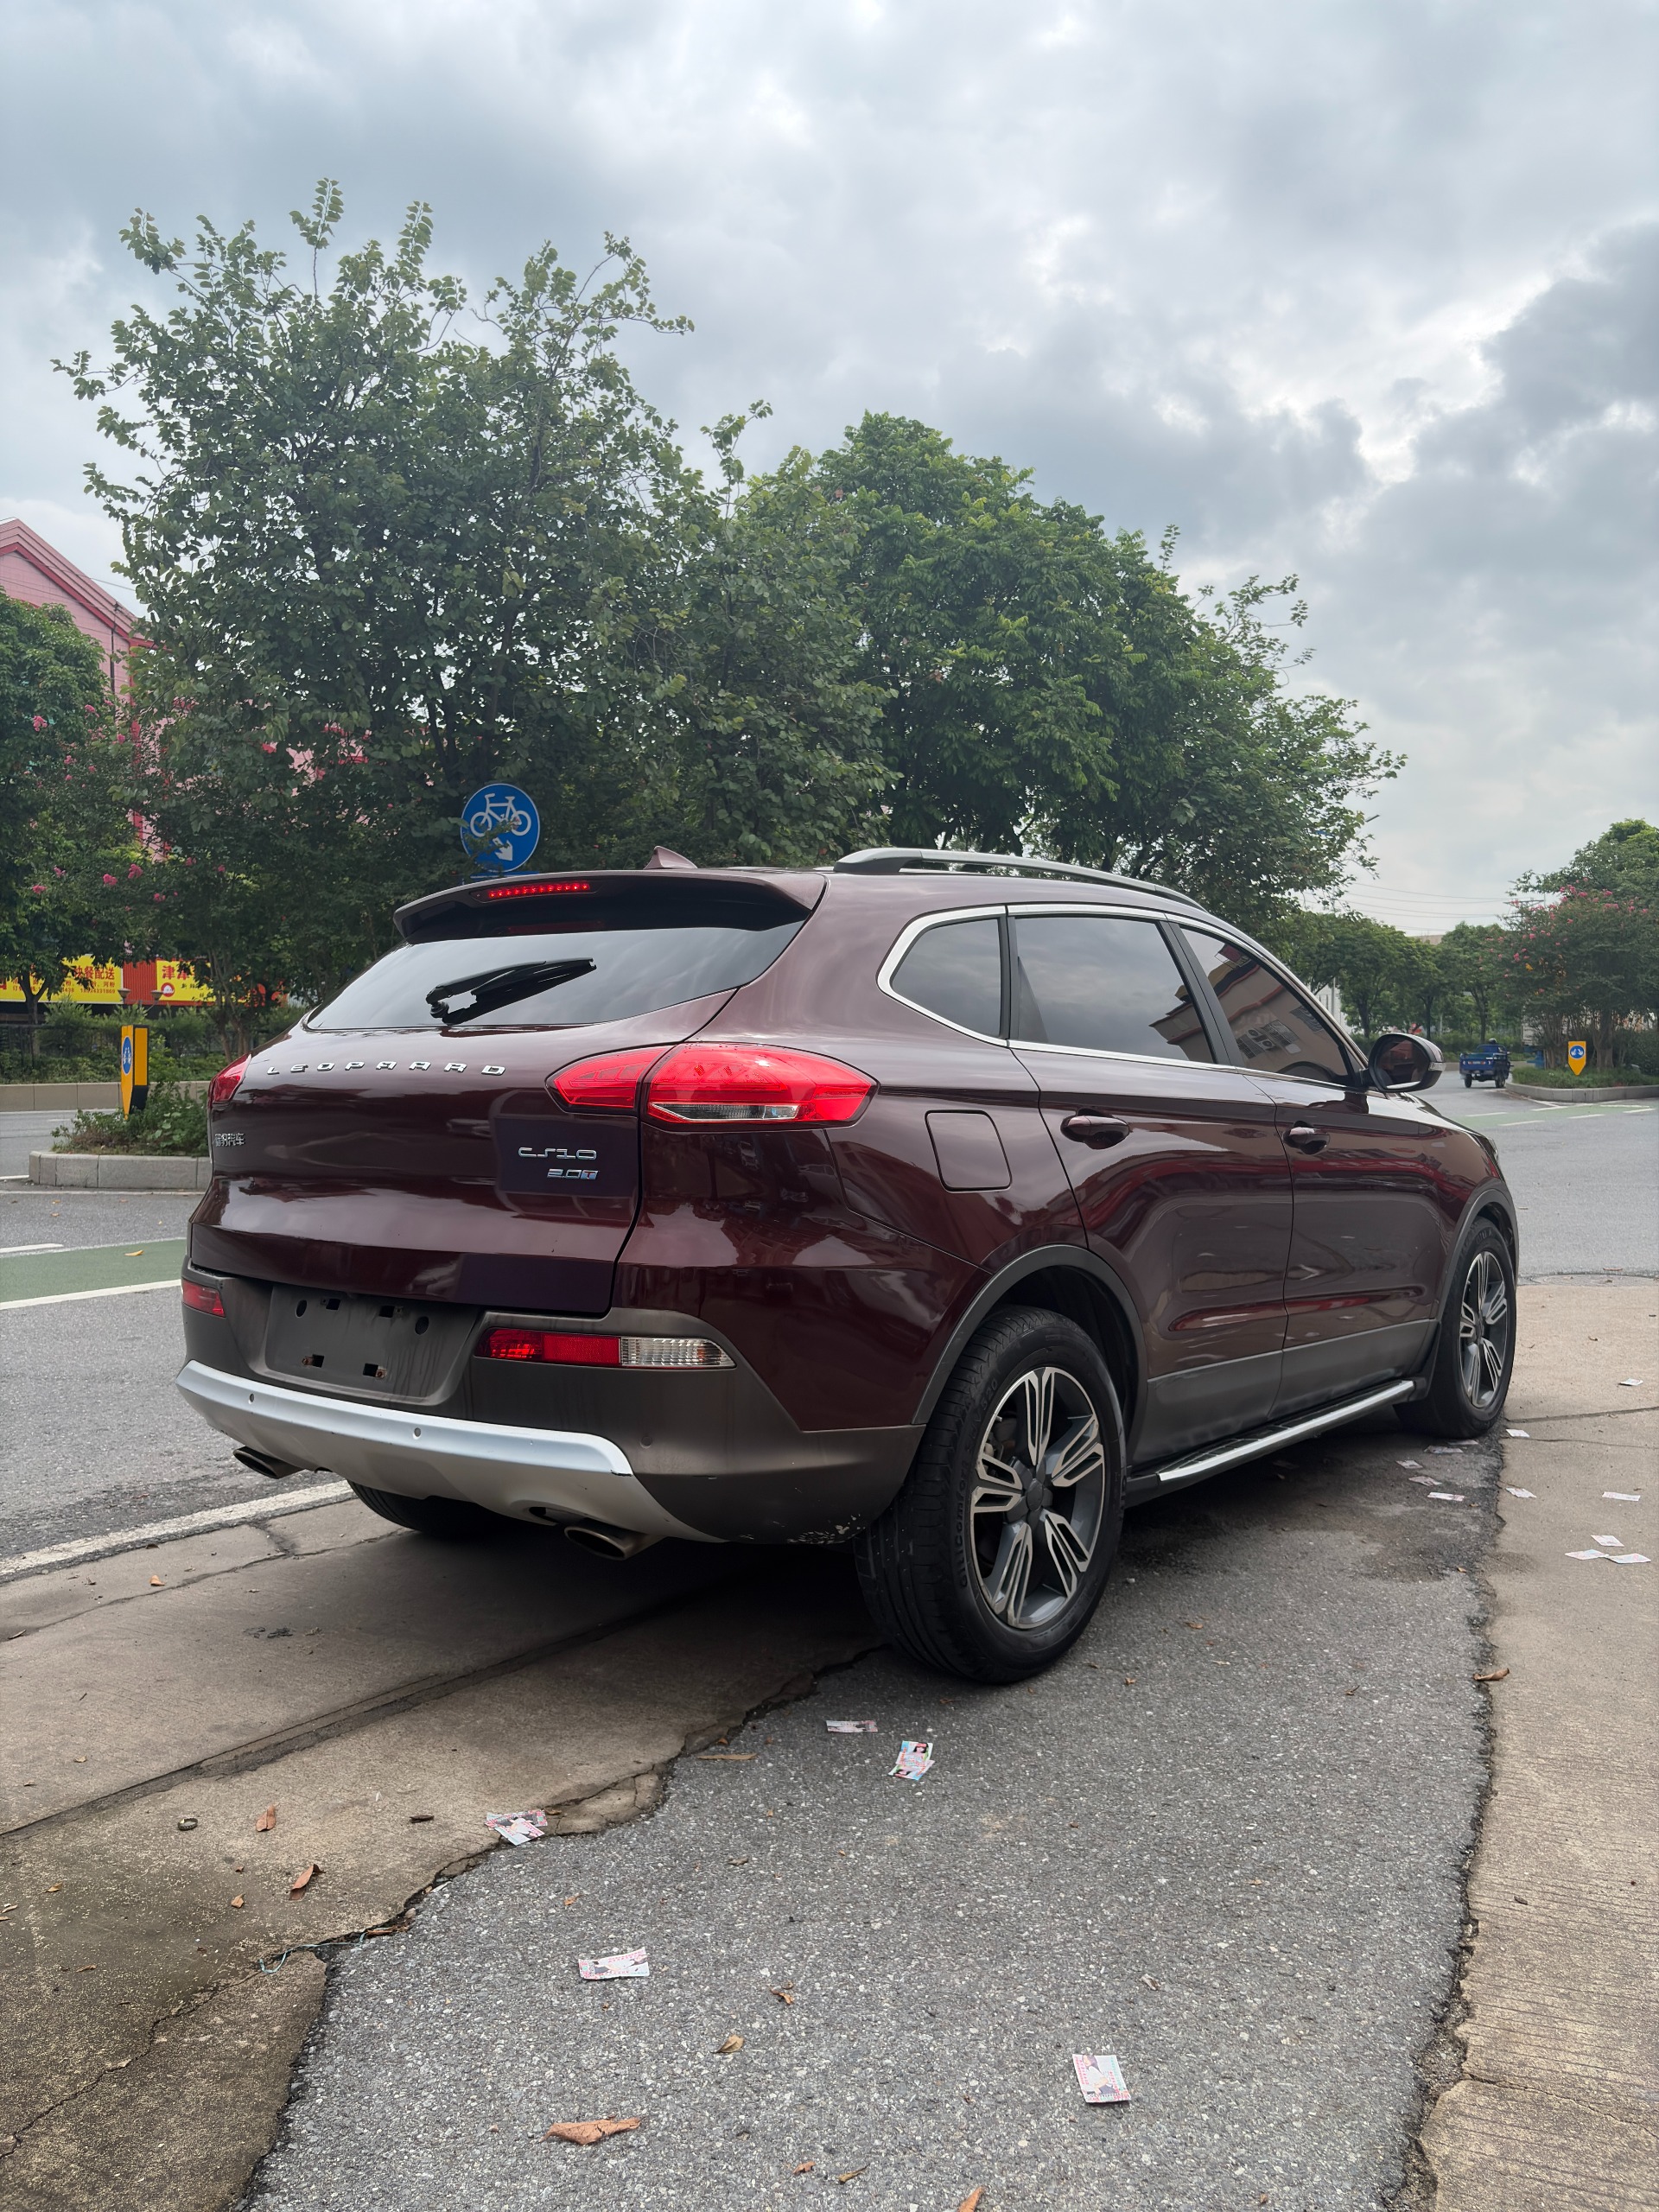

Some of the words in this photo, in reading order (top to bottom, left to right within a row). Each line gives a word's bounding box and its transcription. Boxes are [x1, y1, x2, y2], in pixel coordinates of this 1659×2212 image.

[266, 1060, 506, 1076] LEOPAARD
[518, 1147, 597, 1160] CS10
[546, 1168, 599, 1180] 2.0T
